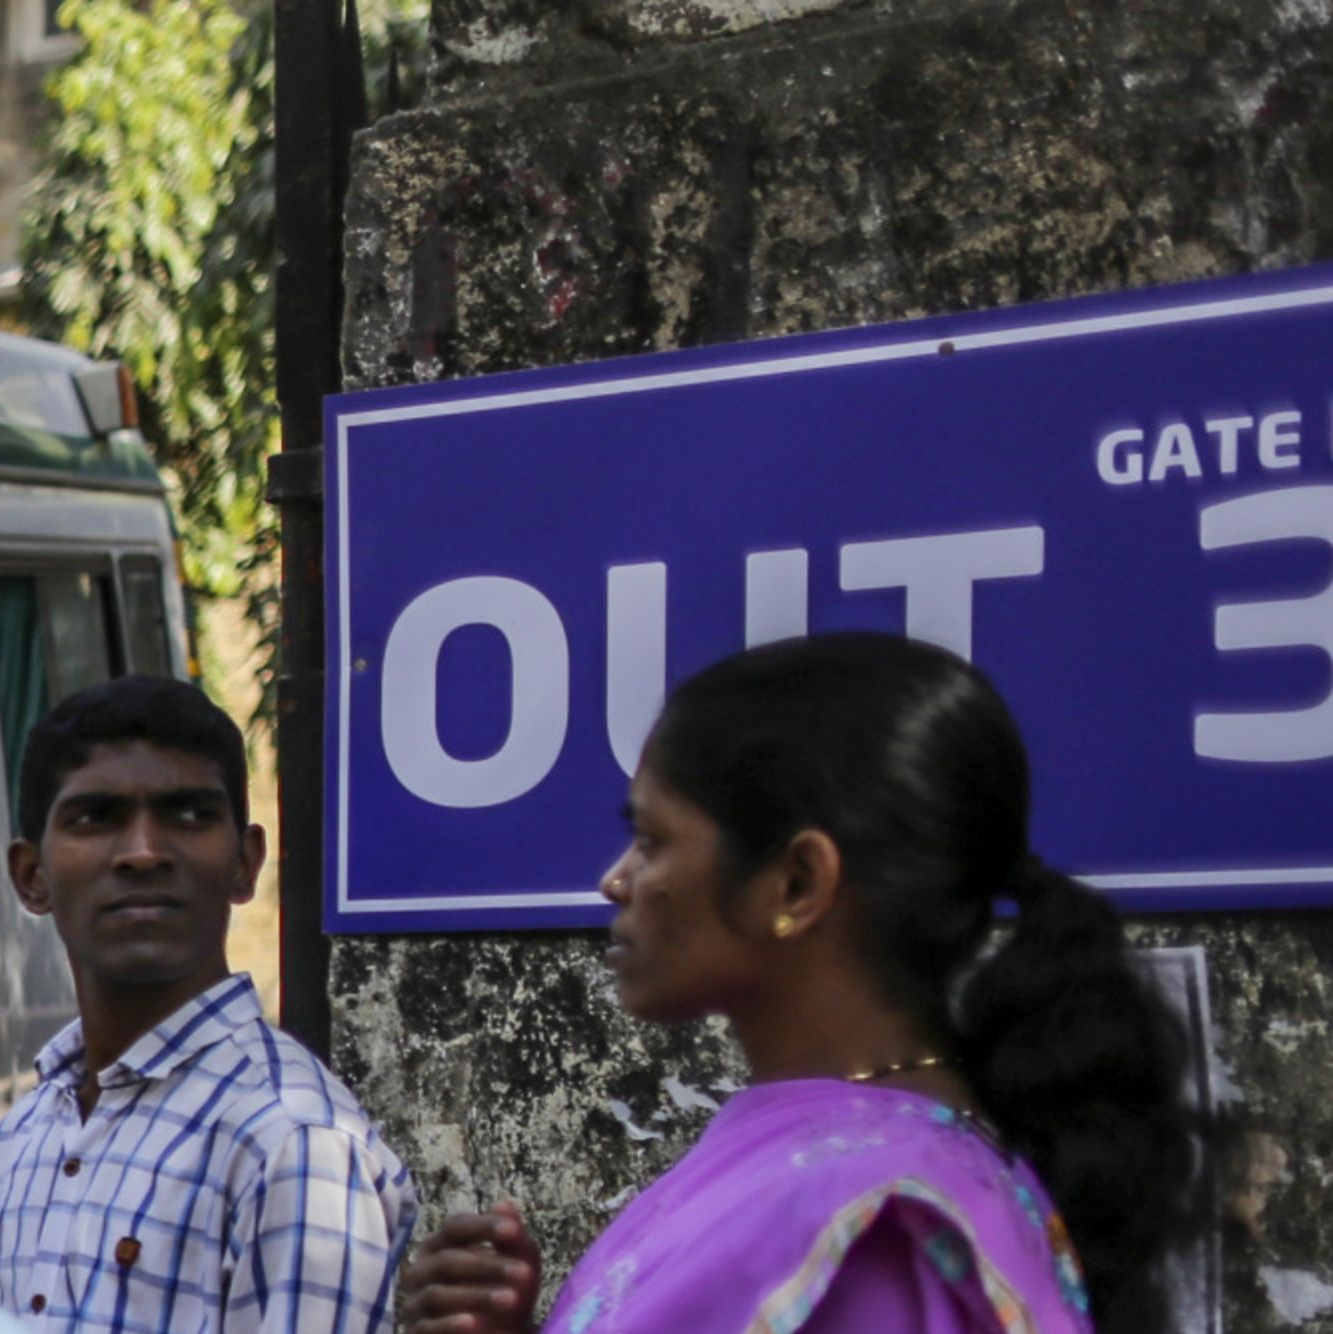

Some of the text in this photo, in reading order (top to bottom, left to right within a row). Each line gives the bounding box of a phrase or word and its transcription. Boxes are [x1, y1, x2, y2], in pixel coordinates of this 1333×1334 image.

[1096, 410, 1302, 485] GATE
[380, 525, 1045, 809] OUT
[1193, 485, 1333, 763] 3
